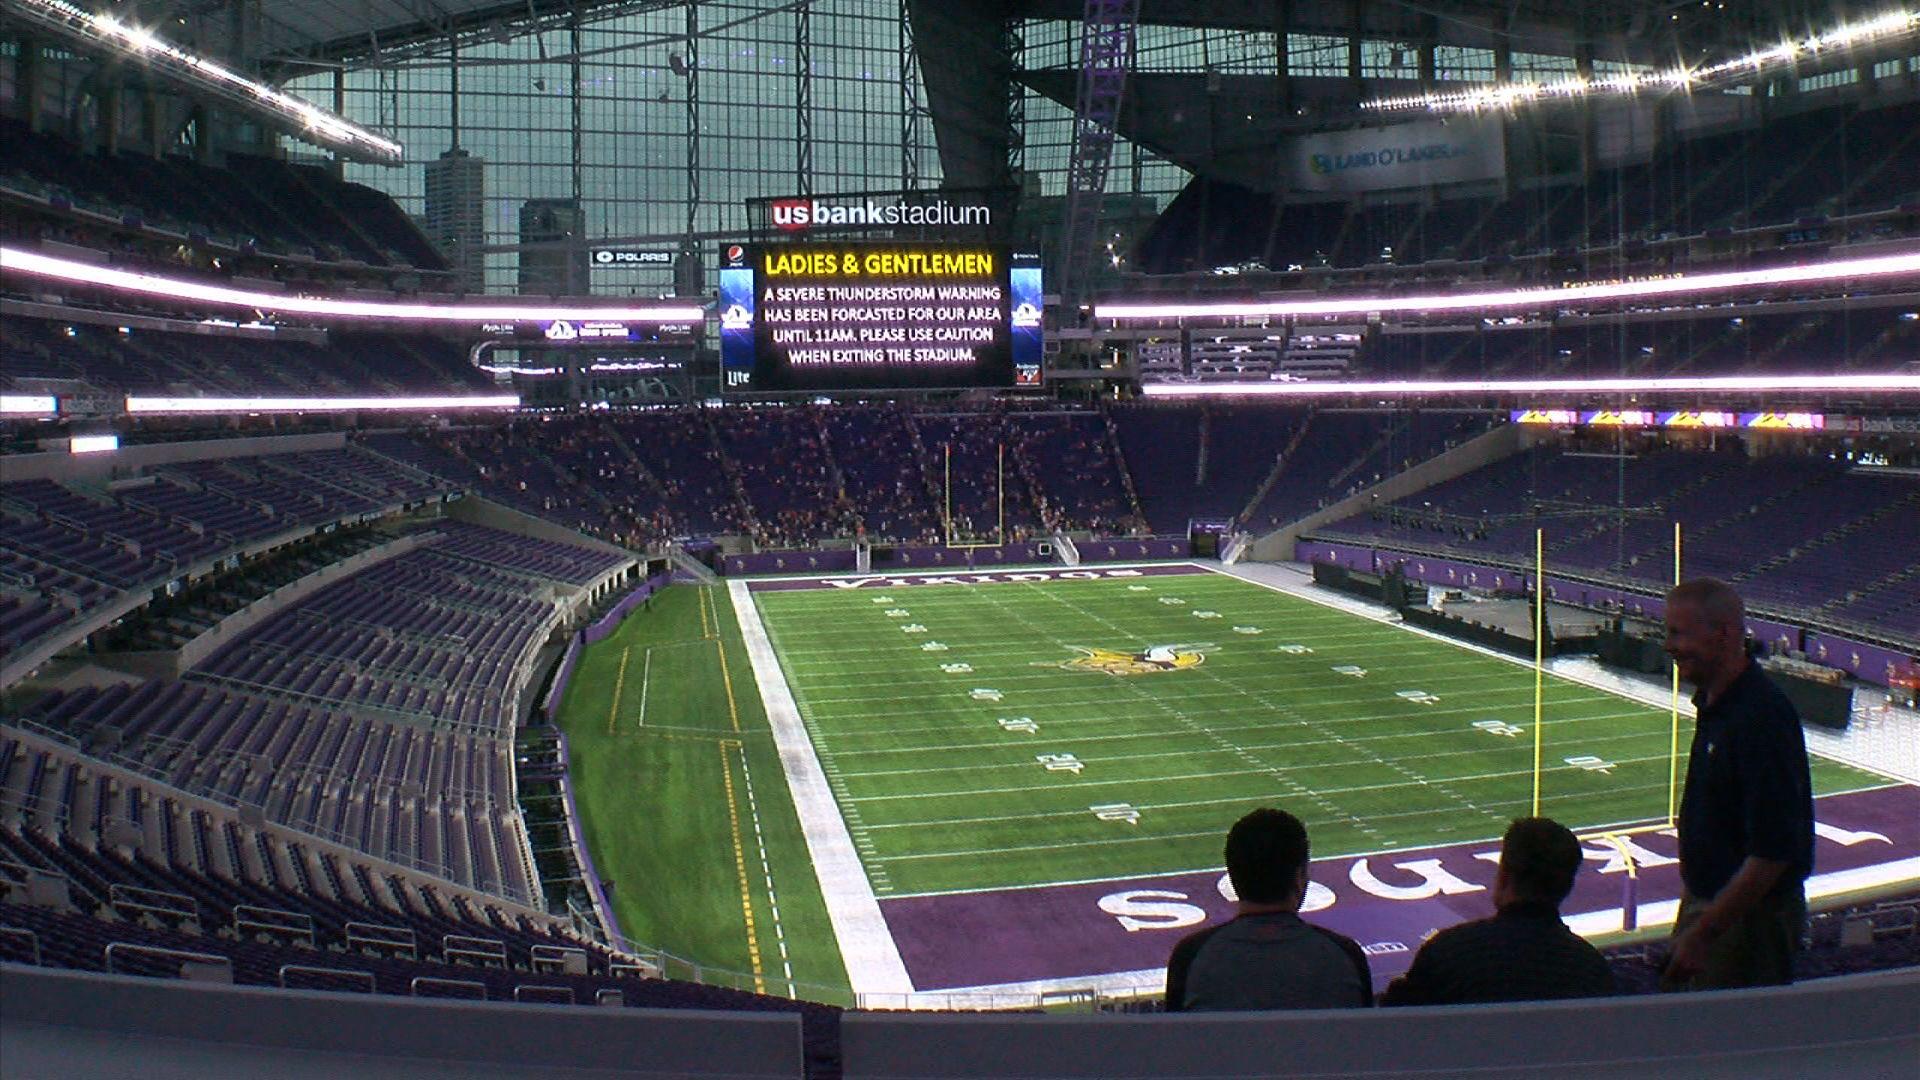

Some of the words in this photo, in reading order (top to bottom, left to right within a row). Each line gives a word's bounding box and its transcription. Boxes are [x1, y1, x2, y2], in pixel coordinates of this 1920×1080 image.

[616, 252, 670, 262] POLARIS
[765, 254, 838, 275] LADIES
[842, 254, 860, 274] &
[864, 254, 993, 274] GENTLEMEN
[764, 287, 775, 301] A
[776, 287, 826, 301] SEVERE
[827, 287, 936, 300] THUNDERSTORM
[938, 287, 1001, 300] WARNING
[764, 308, 792, 322] HAS
[794, 308, 829, 321] BEEN
[831, 307, 906, 321] FORCASTED
[908, 307, 934, 321] FOR
[935, 307, 966, 321] OUR
[967, 307, 1002, 321] AREA
[773, 329, 814, 343] UNTIL
[815, 328, 858, 342] 11AM.
[860, 328, 906, 341] PLEASE
[908, 328, 934, 341] USE
[934, 327, 994, 341] CAUTION
[788, 349, 830, 363] WHEN
[832, 349, 884, 363] EXITING
[886, 349, 912, 362] THE
[913, 348, 976, 362] STADIUM.
[728, 371, 750, 386] Lite
